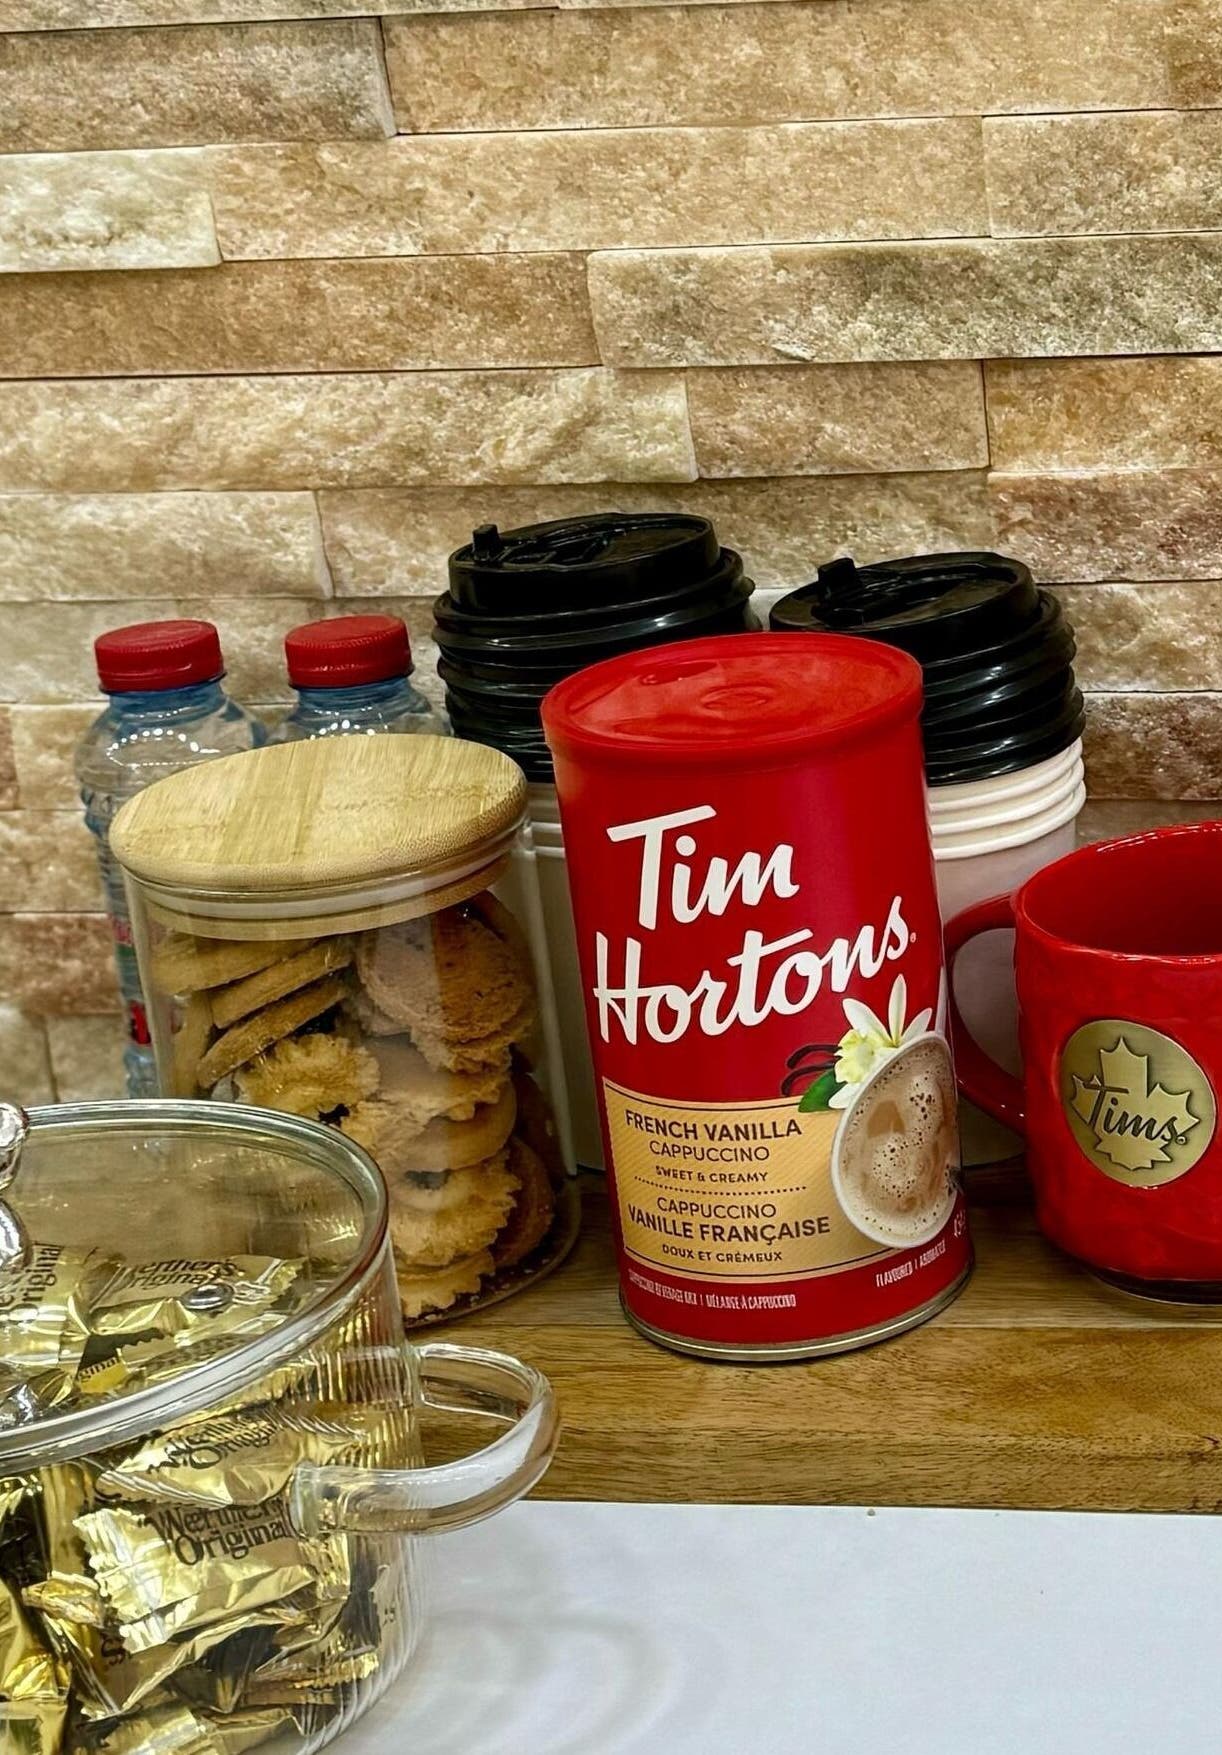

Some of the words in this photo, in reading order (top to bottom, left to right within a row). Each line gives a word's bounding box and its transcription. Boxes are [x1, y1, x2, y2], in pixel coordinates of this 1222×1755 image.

[606, 804, 800, 931] Tim
[592, 895, 910, 1046] Hortons
[625, 1109, 699, 1141] FRENCH
[703, 1119, 803, 1142] VANILLA
[649, 1139, 770, 1162] CAPPUCCINO
[655, 1165, 694, 1181] SWEET
[698, 1171, 706, 1182] &
[709, 1172, 769, 1184] CREAMY
[656, 1196, 777, 1219] CAPPUCCINO
[628, 1203, 694, 1239] VANILLE
[699, 1216, 831, 1246] FRANÇAISE
[662, 1243, 695, 1260] DOUX
[698, 1250, 712, 1261] ET
[715, 1249, 783, 1264] CRÉMEUX
[748, 1293, 797, 1309] CAPPUCCINO
